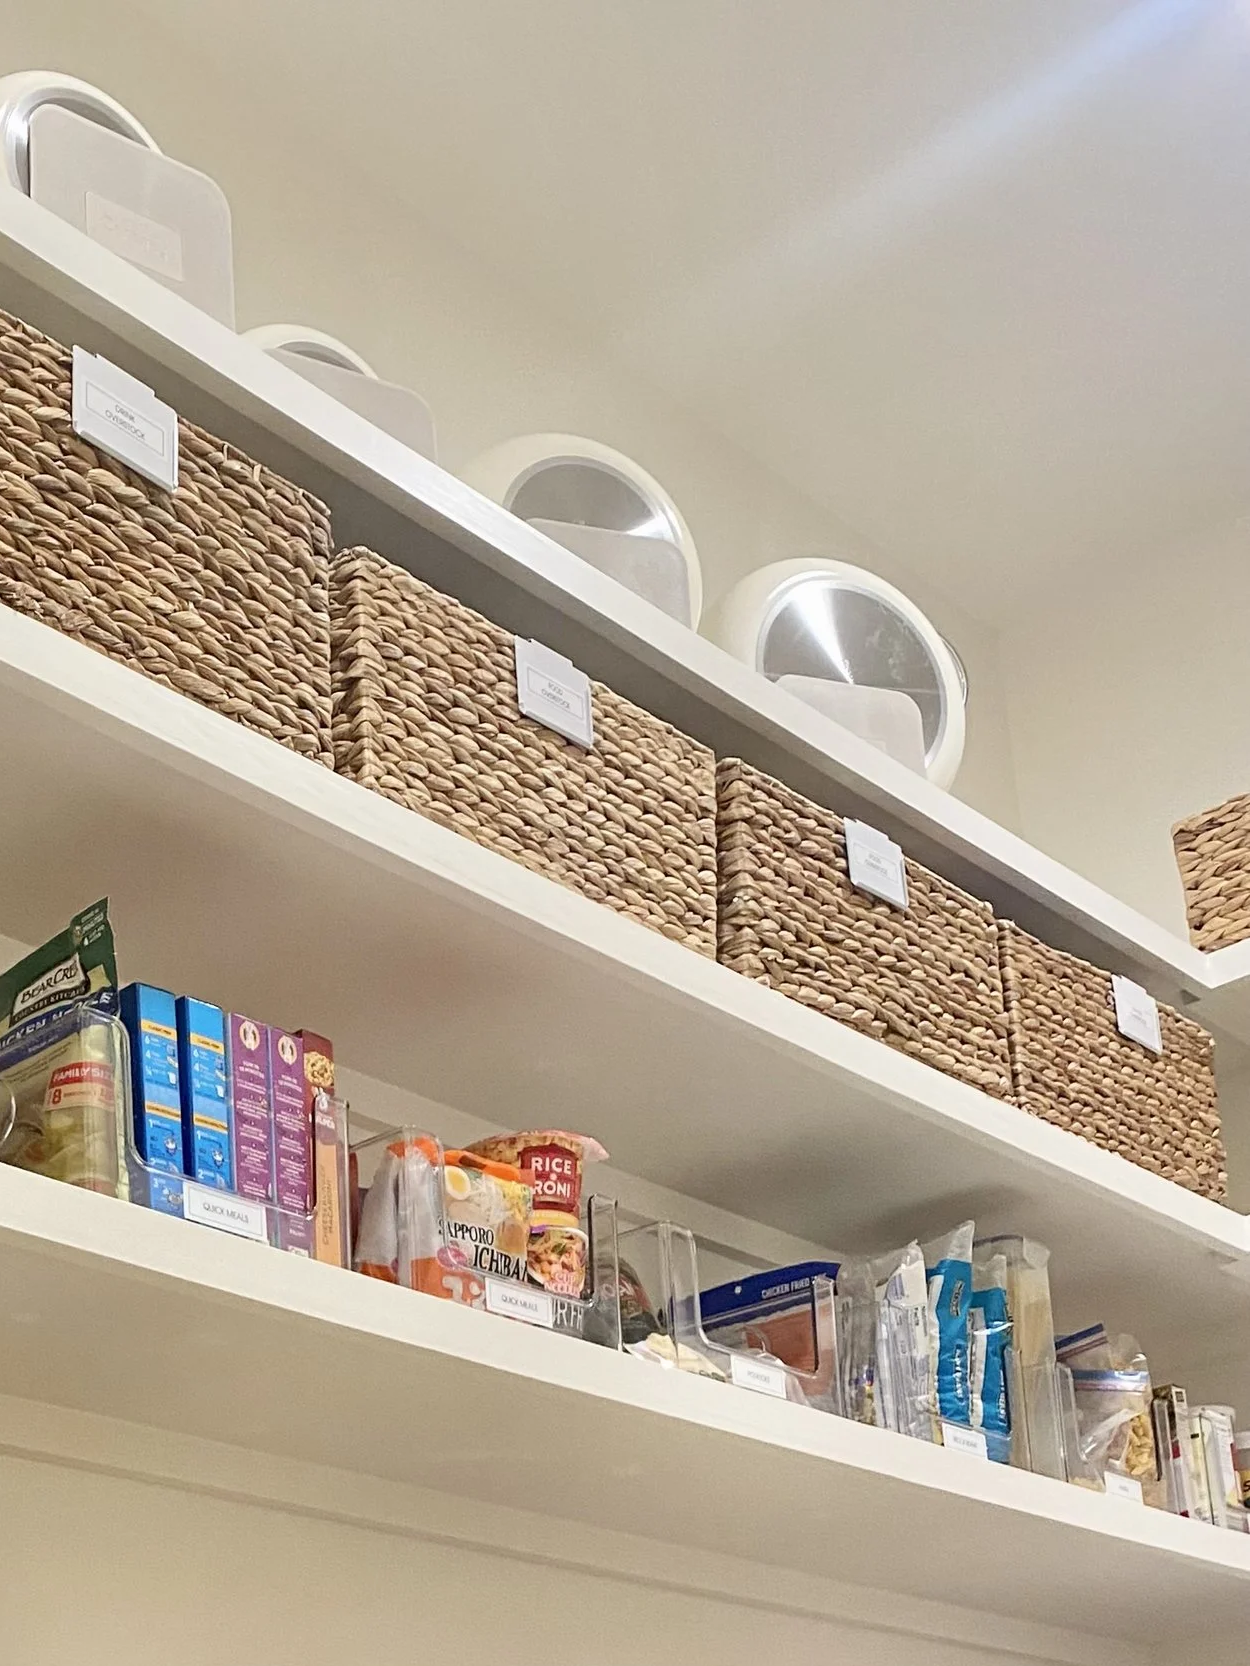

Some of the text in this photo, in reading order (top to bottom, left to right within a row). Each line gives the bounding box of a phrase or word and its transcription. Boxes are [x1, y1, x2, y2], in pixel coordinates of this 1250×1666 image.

[104, 409, 147, 441] OVERSTOCK
[20, 976, 53, 1005] BEAR
[51, 1088, 62, 1105] 8
[530, 1156, 573, 1175] RICE
[532, 1180, 571, 1198] RONI
[202, 1202, 250, 1225] QUICK MEALS
[438, 1215, 495, 1246] SAPPORO
[761, 1277, 810, 1299] CHICKEN FRIED
[500, 1293, 519, 1306] QUICK
